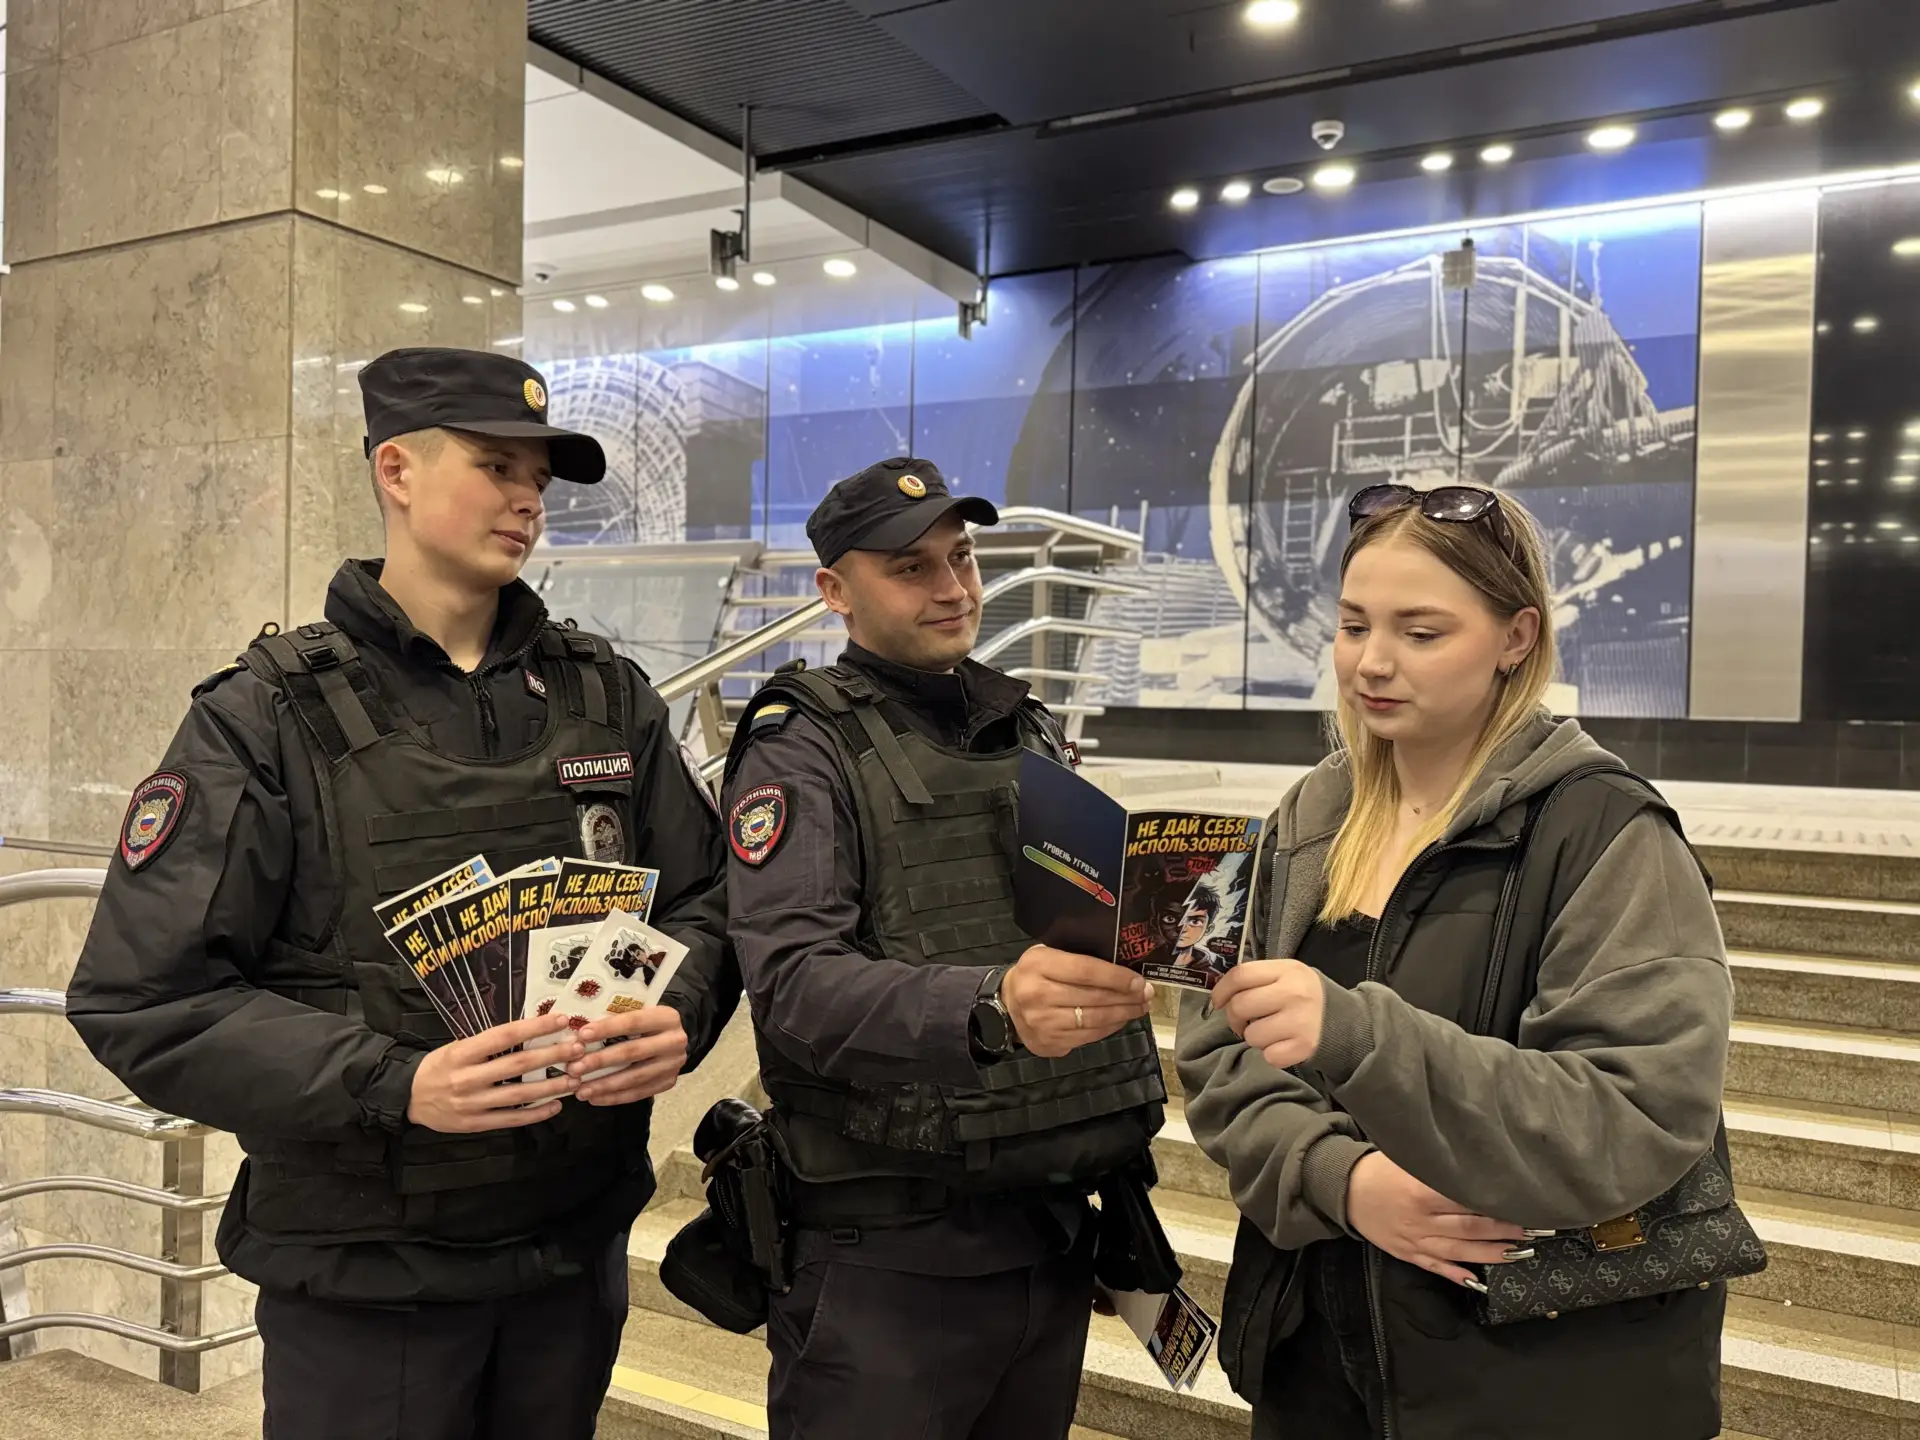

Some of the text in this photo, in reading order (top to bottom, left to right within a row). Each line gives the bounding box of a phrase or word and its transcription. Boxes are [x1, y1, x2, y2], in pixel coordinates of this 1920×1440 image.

[562, 758, 631, 778] ПОЛИЦИЯ
[136, 777, 182, 800] ПОЛИЦИЯ
[733, 788, 781, 818] ПОЛИЦИЯ
[1137, 815, 1249, 838] НЕ ДАЙ СЕБЯ
[749, 845, 768, 860] МВД
[1127, 833, 1257, 857] ИСПОЛЬЗОВАТЬ!
[1043, 841, 1099, 879] УРОВЕНЬ УГРОЗЫ
[564, 870, 648, 895] НЕ ДАЙ СЕБЯ
[519, 886, 537, 909] НЕ
[552, 889, 651, 915] ИСПОЛЬЗОВАТЬ!
[459, 904, 480, 931] НЕ
[405, 929, 428, 957] НЕ
